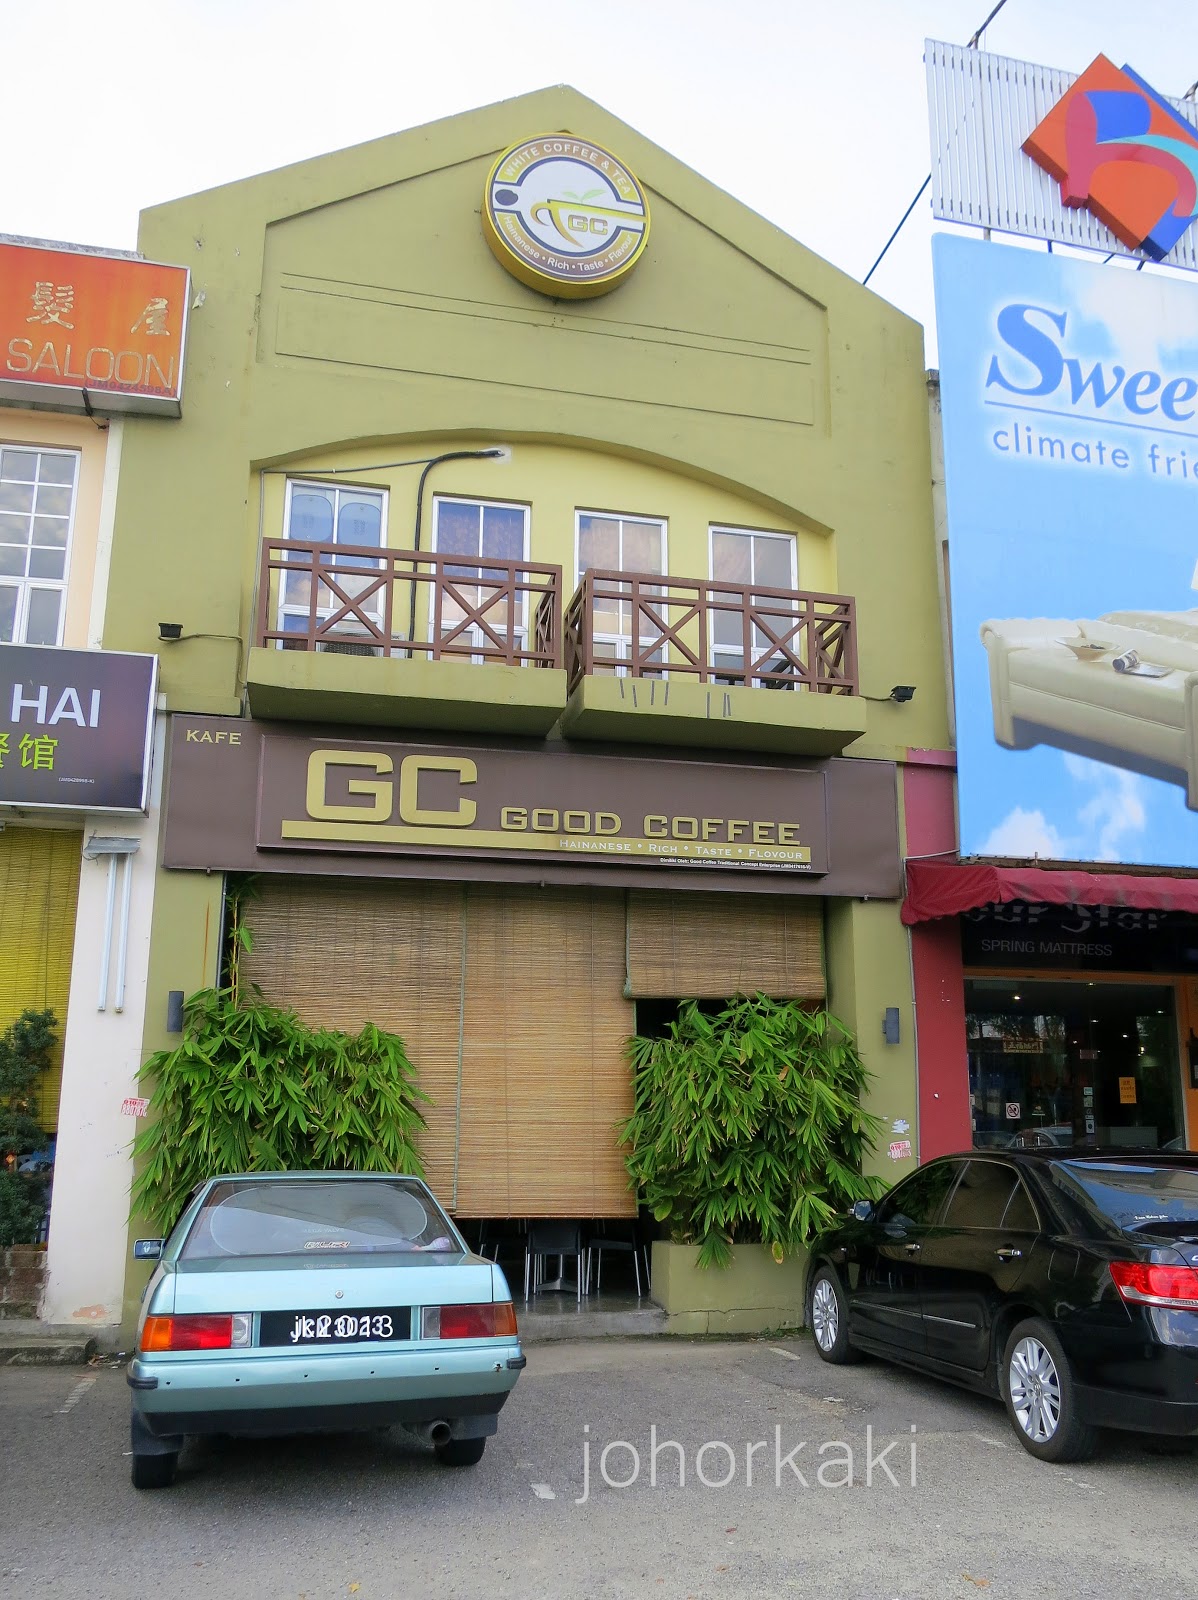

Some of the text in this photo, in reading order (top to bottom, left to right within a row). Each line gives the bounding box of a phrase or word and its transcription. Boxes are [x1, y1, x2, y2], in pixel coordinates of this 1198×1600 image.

[504, 143, 631, 194] WHITE COFFEE & TEA
[503, 215, 634, 272] Hainanese Rich Taste Flavour
[567, 214, 608, 236] GC
[6, 337, 174, 389] SALOON
[985, 303, 1198, 422] Swee
[993, 422, 1130, 469] climate
[11, 683, 101, 728] HAI
[186, 729, 242, 745] KAFE
[306, 749, 478, 827] GC
[501, 806, 801, 845] GOOD COFFEE
[559, 839, 803, 859] HAINANESE RICH TASTE FLOVOUR
[981, 938, 1113, 957] SPRING MATTRESS
